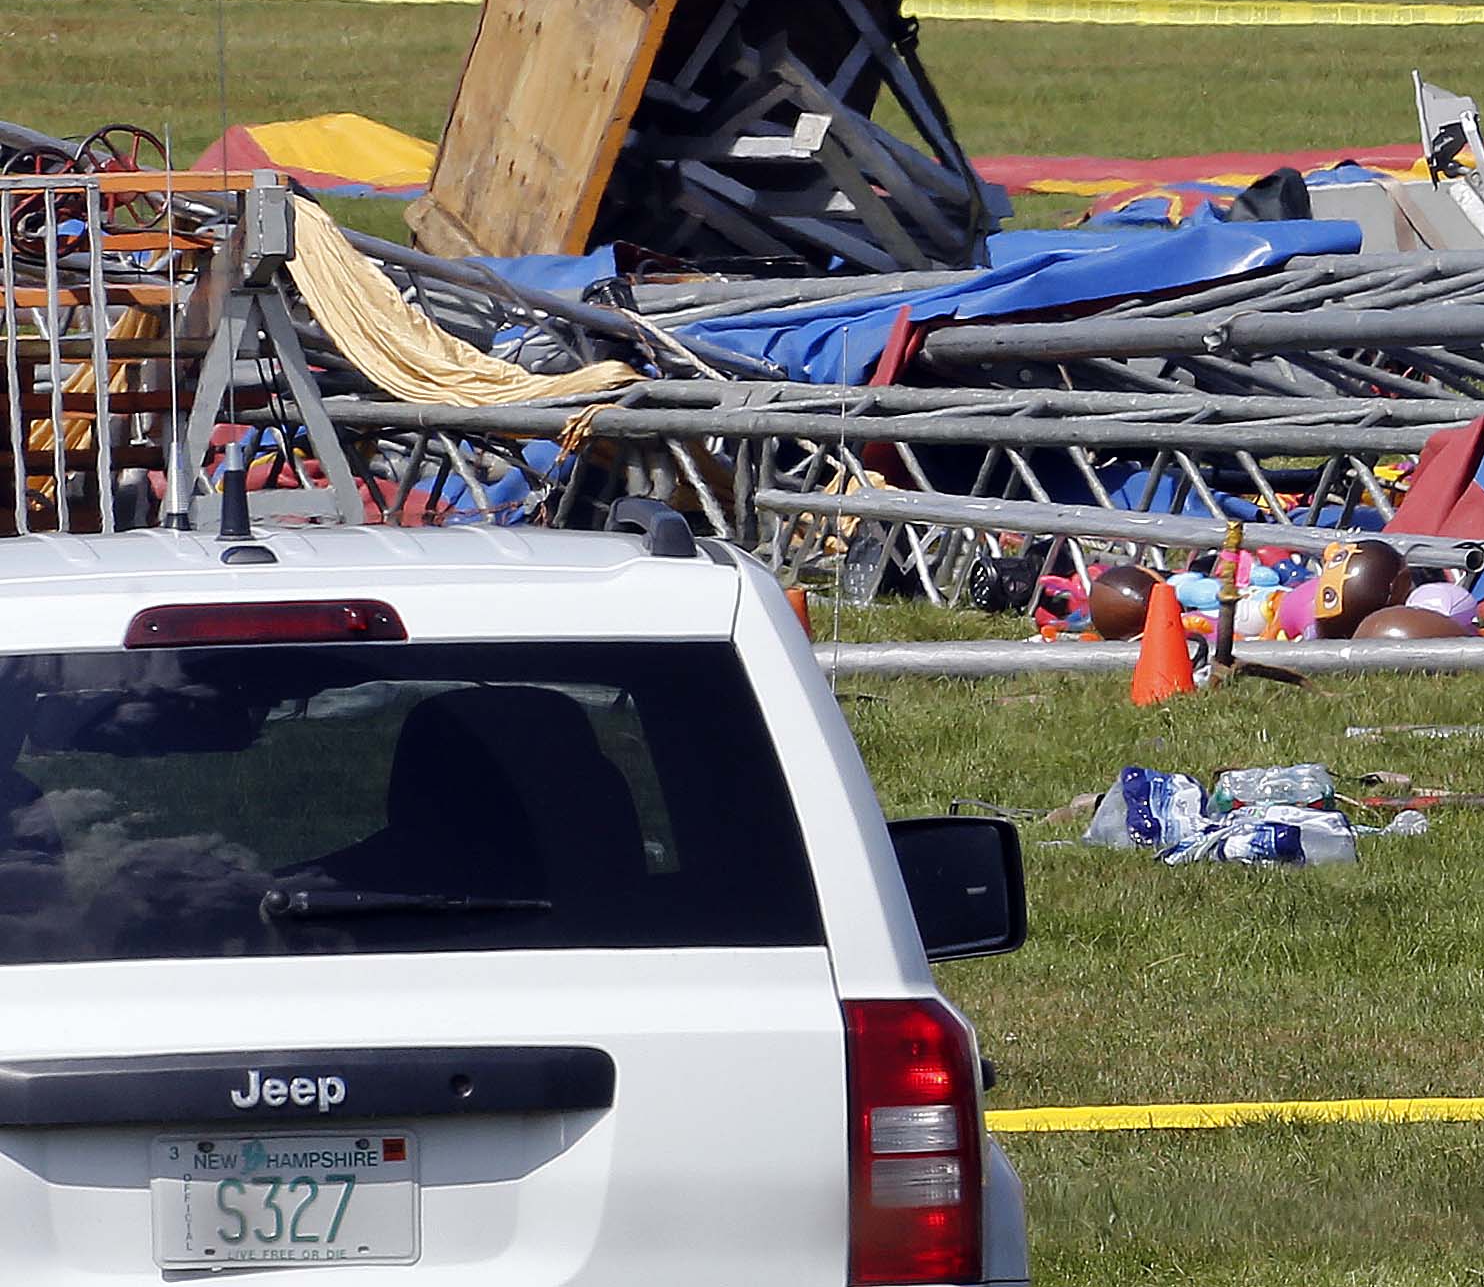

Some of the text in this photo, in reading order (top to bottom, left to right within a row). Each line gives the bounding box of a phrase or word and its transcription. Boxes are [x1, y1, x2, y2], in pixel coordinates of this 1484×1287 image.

[231, 1070, 346, 1112] Jeep
[169, 1146, 180, 1160] 3
[194, 1151, 379, 1170] NEW HAMPSHIRE
[183, 1173, 193, 1251] OFFICIAL
[217, 1173, 356, 1243] S327
[228, 1248, 347, 1261] LIVE FREE OR DIE
